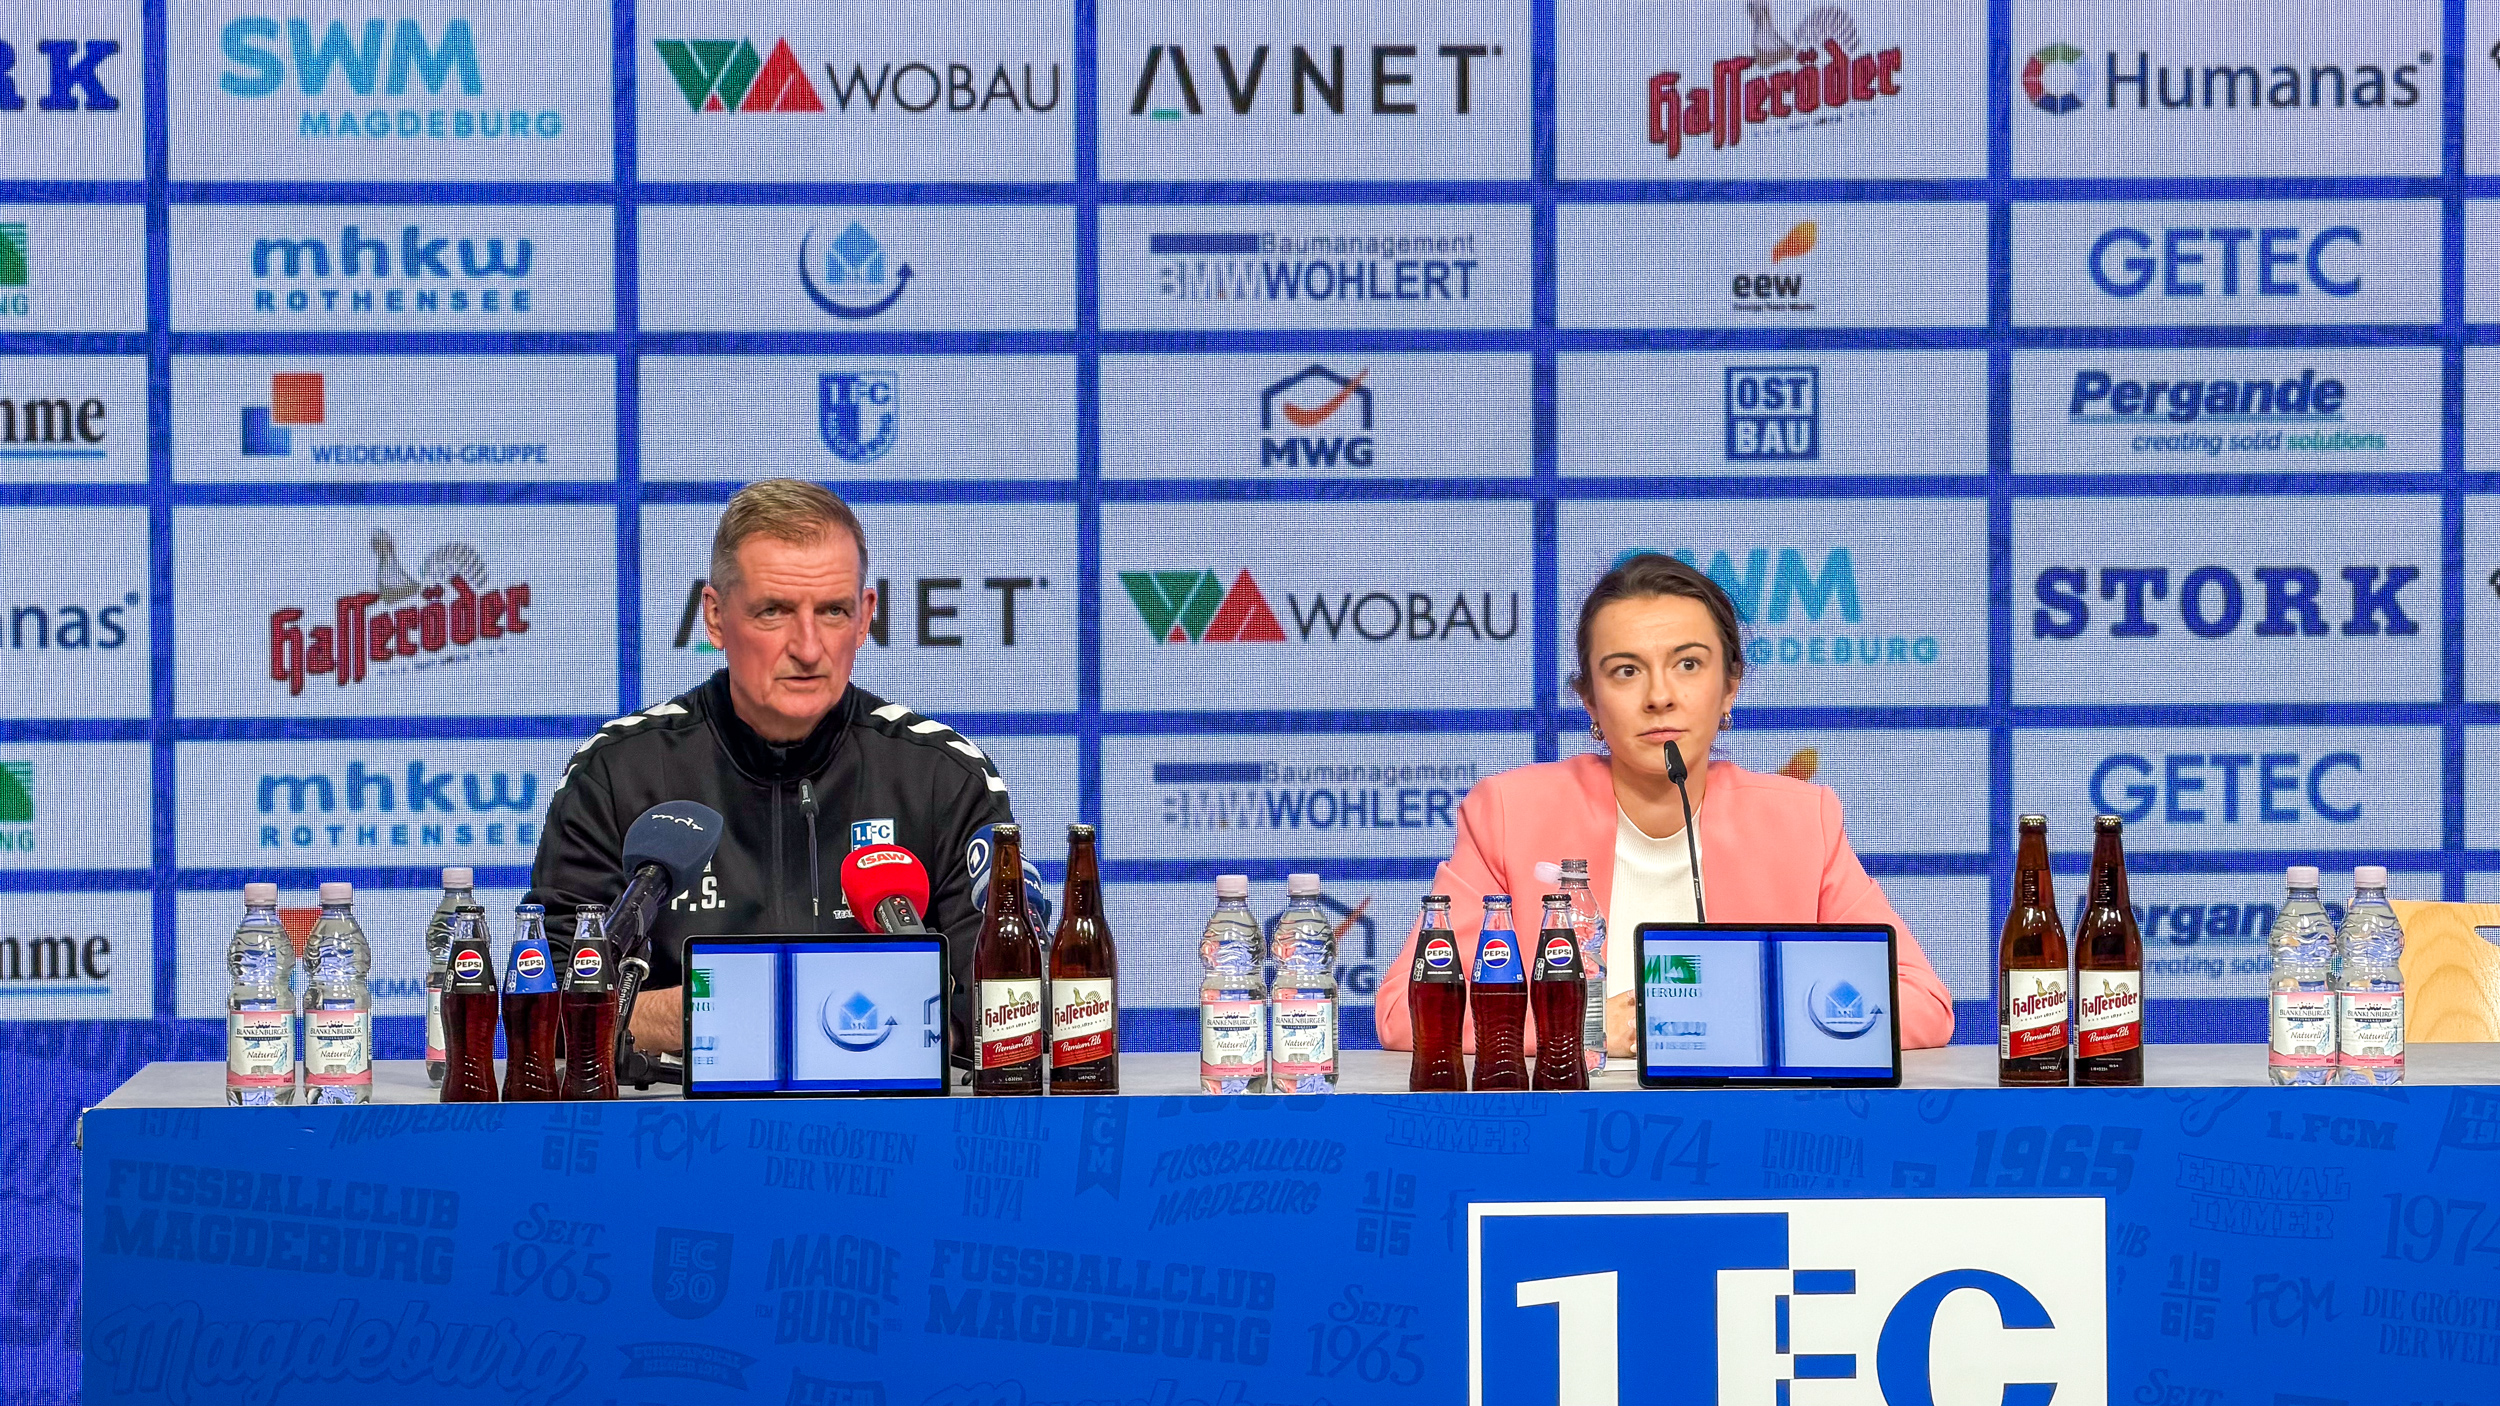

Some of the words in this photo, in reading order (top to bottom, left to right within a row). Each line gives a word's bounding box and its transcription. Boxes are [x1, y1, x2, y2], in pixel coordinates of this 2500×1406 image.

[220, 16, 483, 97] SWM
[825, 62, 1061, 113] WOBAU
[1131, 46, 1488, 116] AVNET
[300, 109, 562, 138] MAGDEBURG
[252, 225, 533, 278] mhkw
[1262, 233, 1478, 257] Baumanagement
[2089, 226, 2361, 297] GETEC
[254, 290, 532, 312] ROTHENSEE
[1731, 273, 1802, 298] eew
[1737, 378, 1809, 410] OST
[2069, 369, 2346, 422] Pergande
[311, 444, 548, 465] WEIDEMANN-GRUPPE
[1262, 437, 1373, 467] MWG
[1736, 421, 1809, 454] BAU
[2132, 433, 2222, 455] creating
[2227, 432, 2281, 450] solid
[2287, 431, 2387, 450] solutions
[1288, 592, 1519, 641] WOBAU
[2033, 566, 2420, 638] STORK
[0, 602, 127, 648] nas
[257, 760, 539, 813] mhkw
[1266, 761, 1476, 787] Baumanagement
[2090, 751, 2362, 824] GETEC
[260, 824, 536, 847] ROTHENSEE
[865, 853, 905, 865] SAW
[519, 960, 544, 968] PEPSI
[575, 959, 600, 967] PEPSI
[1547, 948, 1572, 956] PEPSI
[310, 1027, 361, 1036] BLANKENBURGER
[1275, 1016, 1325, 1024] BLANKENBURGER
[2279, 1009, 2331, 1017] BLANKENBURGER
[2347, 1010, 2398, 1018] BLANKENBURGER
[236, 1028, 288, 1036] BLANKENBURGER
[993, 1042, 1024, 1053] Premium
[1061, 1041, 1090, 1052] Premium
[1217, 1040, 1249, 1049] Naturell
[1284, 1038, 1316, 1047] Naturell
[2020, 1032, 2051, 1042] Premium
[2088, 1032, 2118, 1042] Premium
[2290, 1031, 2322, 1039] Naturell
[2358, 1032, 2390, 1040] Naturell
[247, 1050, 280, 1059] Naturell
[320, 1049, 352, 1058] Naturell
[629, 1105, 729, 1173] FCM
[748, 1117, 793, 1151] DIE
[1385, 1110, 1531, 1155] IMMER
[1577, 1107, 1721, 1187] 1974
[953, 1135, 1041, 1179] SIEGER
[1149, 1138, 1346, 1188] FUSSBALLCLUB
[1761, 1127, 1865, 1179] EUROPA
[1969, 1124, 2144, 1196] 1965
[105, 1157, 461, 1231] FUSSBALLCLUB
[763, 1155, 817, 1192] DER
[823, 1161, 895, 1199] WELT
[2176, 1152, 2351, 1201] EINMAL
[961, 1174, 1025, 1222] 1974
[1149, 1179, 1321, 1232] MAGDEBURG
[2190, 1192, 2334, 1240] IMMER
[99, 1204, 456, 1286] MAGDEBURG
[489, 1240, 612, 1306] 1965
[929, 1238, 1277, 1312] FUSSBALLCLUB
[774, 1288, 881, 1356] BURG
[2246, 1272, 2345, 1338] FCM
[2361, 1285, 2405, 1322] DIE
[924, 1285, 1272, 1367] MAGDEBURG
[2378, 1322, 2429, 1359] DER
[90, 1298, 589, 1406] Magdeburg
[1304, 1321, 1426, 1387] 1965
